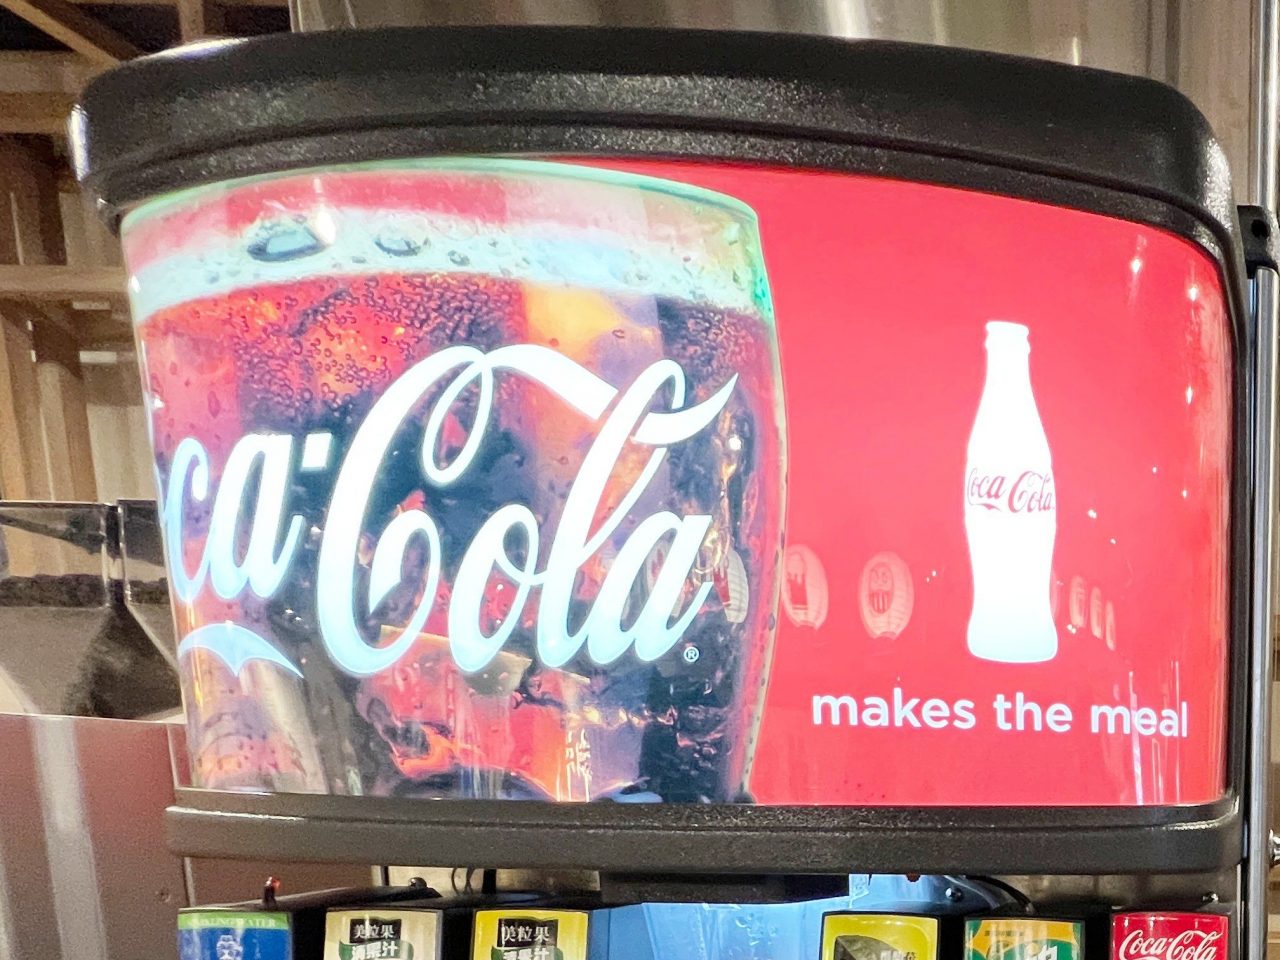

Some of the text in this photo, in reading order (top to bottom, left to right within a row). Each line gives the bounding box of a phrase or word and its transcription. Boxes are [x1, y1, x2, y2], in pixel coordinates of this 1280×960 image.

[812, 687, 1188, 738] makes the meal
[354, 924, 395, 939] 美粒果
[502, 926, 550, 942] 美粒果
